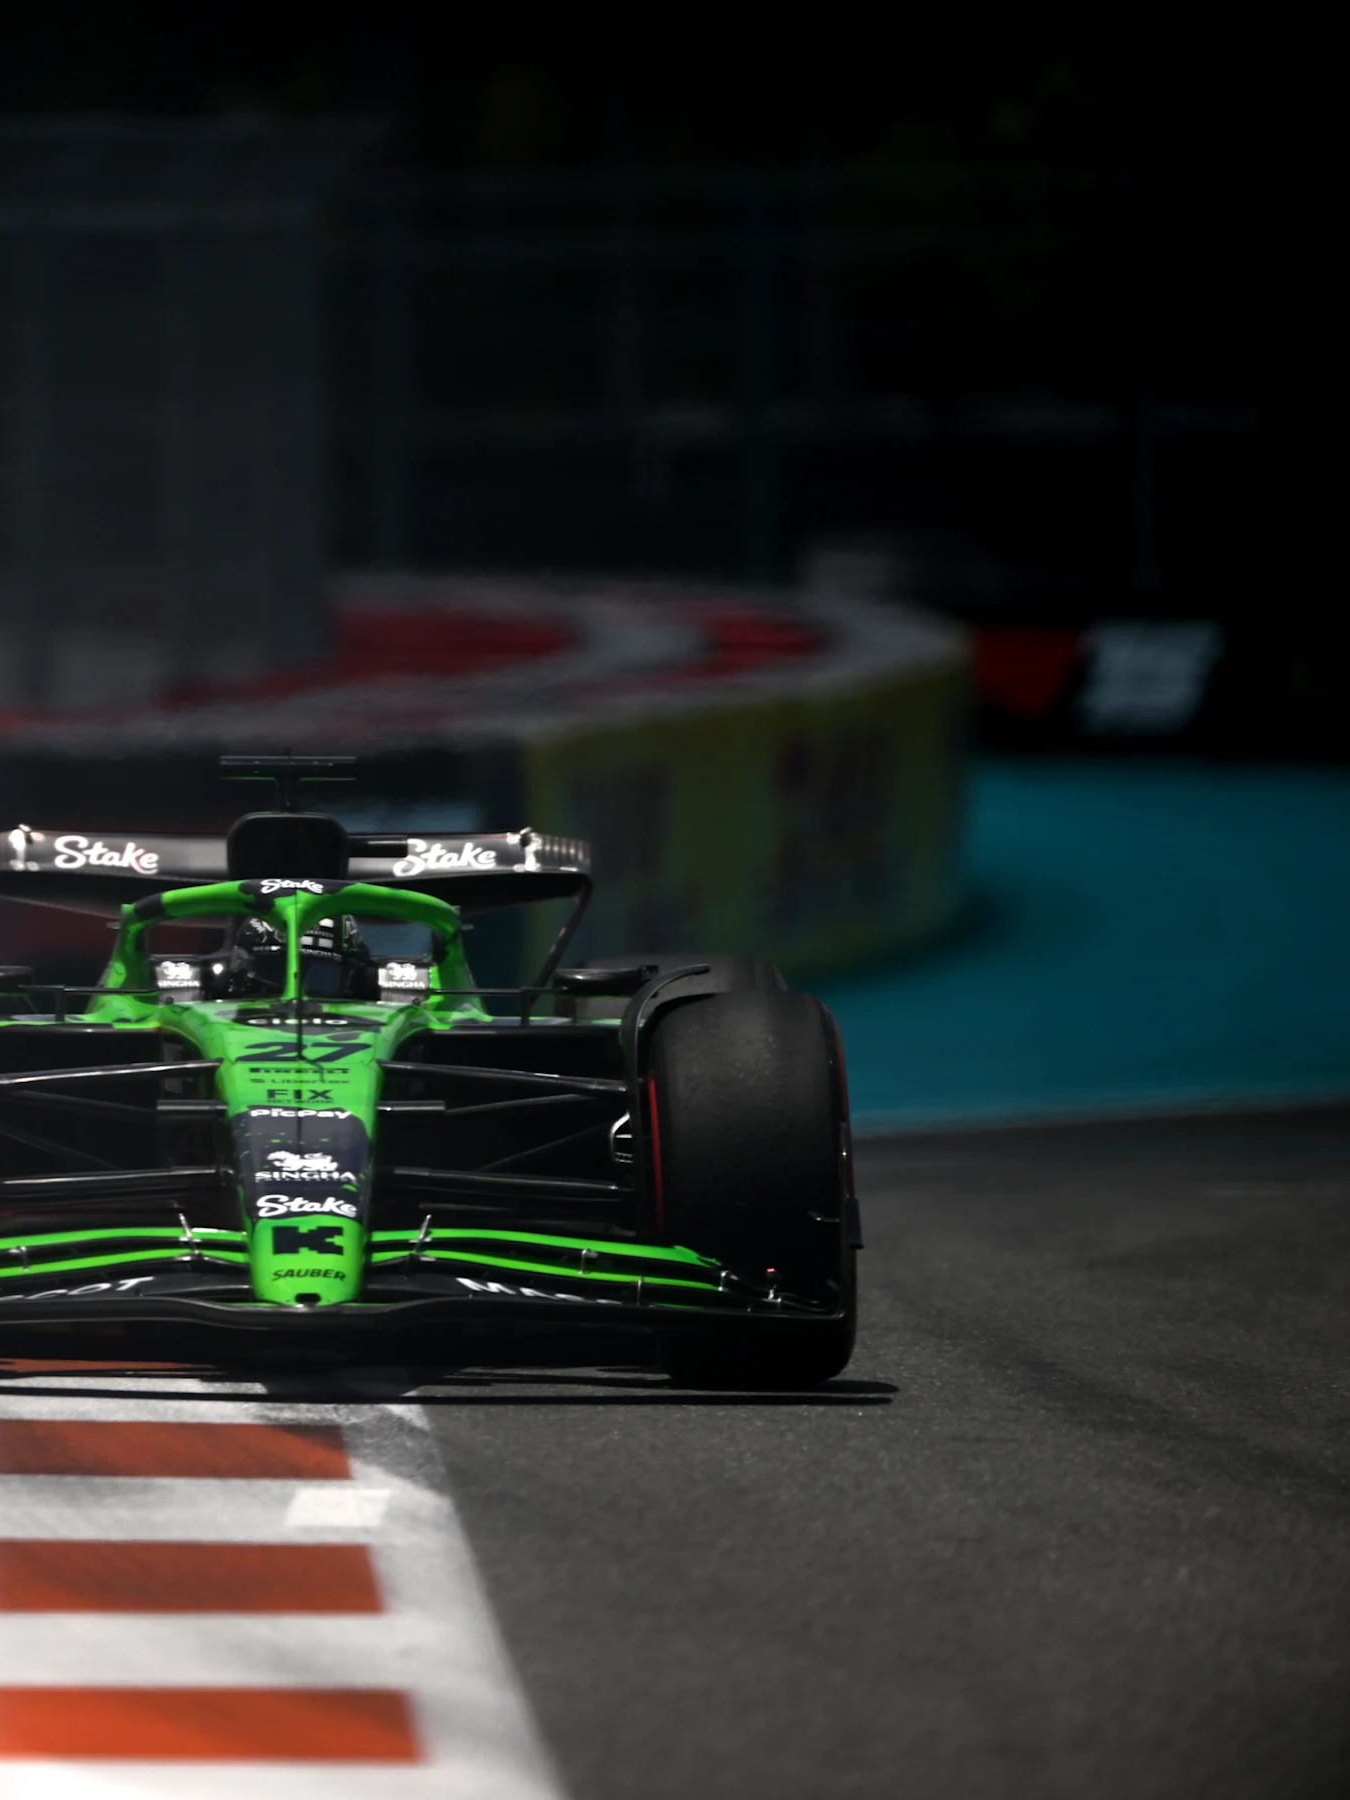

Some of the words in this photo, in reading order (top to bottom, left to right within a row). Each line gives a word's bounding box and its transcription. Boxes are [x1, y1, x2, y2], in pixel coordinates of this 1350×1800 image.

[54, 835, 158, 874] Stake
[393, 838, 496, 877] Stake
[260, 878, 323, 894] Stake
[235, 1042, 372, 1062] 27
[267, 1089, 332, 1100] FIX
[250, 1108, 352, 1119] PicPay
[255, 1171, 357, 1183] SINGHA
[256, 1194, 358, 1218] Stake
[271, 1269, 346, 1281] SAUBER
